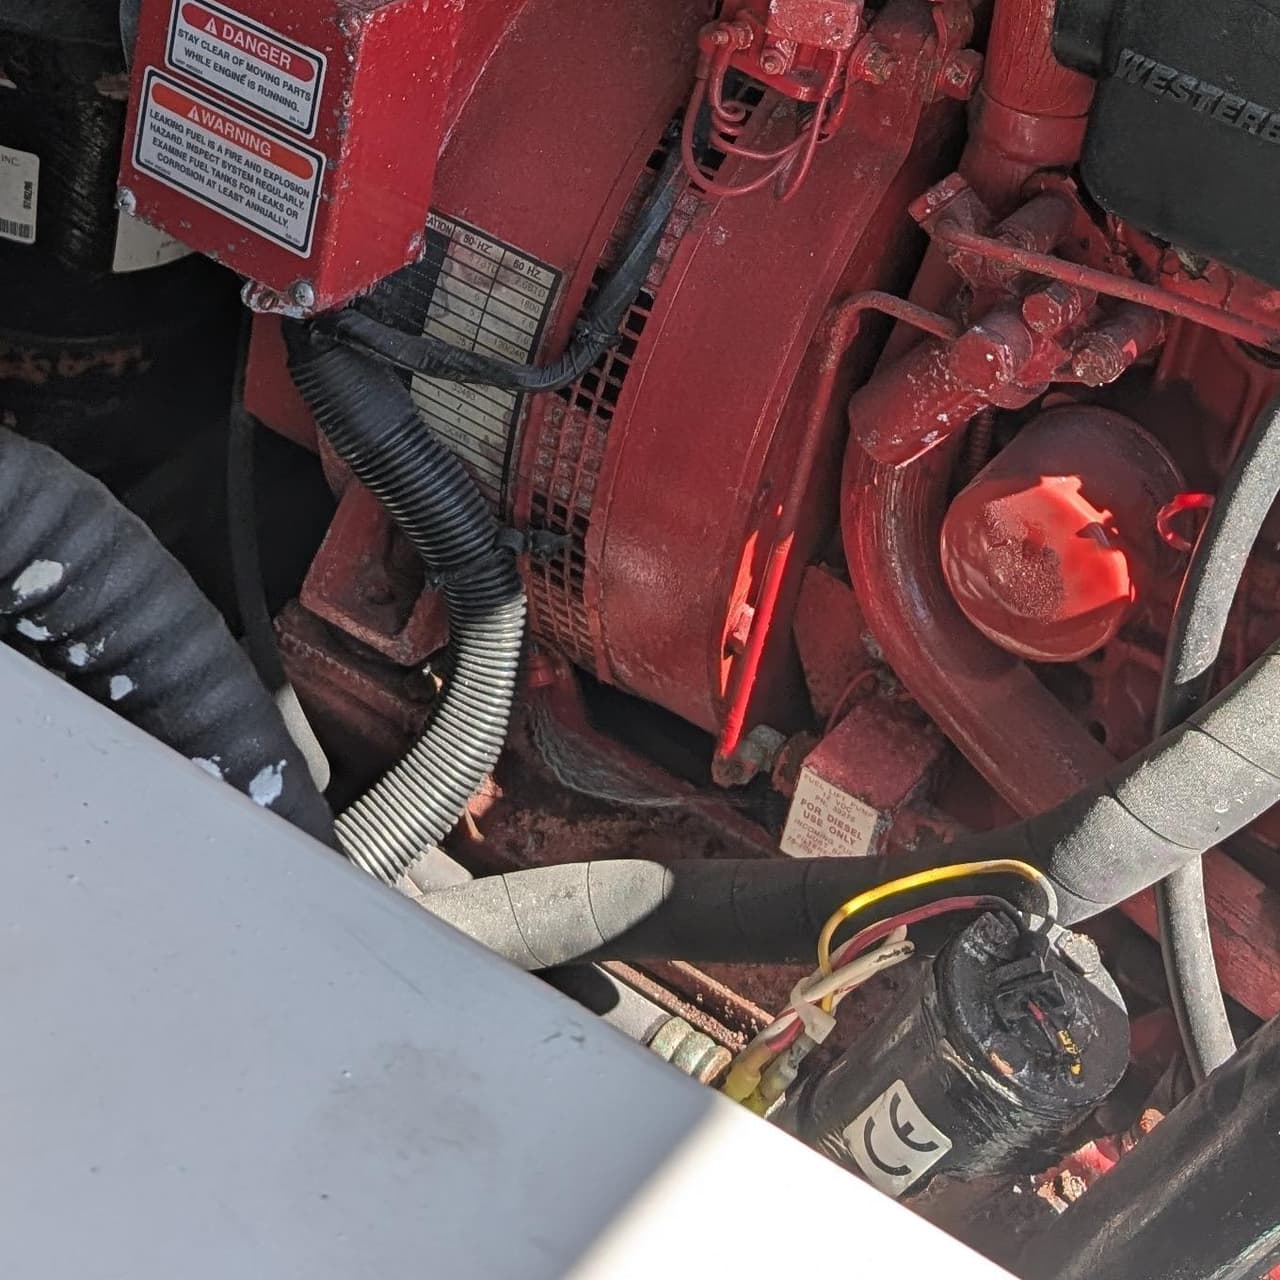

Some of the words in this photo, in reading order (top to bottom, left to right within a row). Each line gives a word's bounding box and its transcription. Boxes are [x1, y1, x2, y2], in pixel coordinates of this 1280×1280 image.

[177, 27, 200, 45] STAY
[200, 39, 230, 62] CLEAR
[231, 55, 245, 68] OF
[246, 62, 281, 88] MOVING
[282, 79, 312, 102] PARTS
[184, 47, 211, 69] WHILE
[213, 63, 247, 86] ENGINE
[247, 78, 256, 90] IS
[258, 84, 300, 113] RUNNING.
[222, 23, 292, 70] DANGER
[149, 109, 185, 134] LEAKING
[185, 127, 207, 146] FUEL
[207, 140, 216, 150] IS
[217, 144, 223, 154] A
[224, 148, 243, 164] FIRE
[244, 158, 262, 175] AND
[263, 168, 310, 199] EXPLOSION
[150, 122, 185, 147] HAZARD.
[186, 141, 220, 166] INSPECT
[221, 160, 254, 184] SYSTEM
[255, 178, 305, 211] REGULARLY.
[200, 109, 271, 158] WARNING
[152, 136, 188, 161] EXAMINE
[189, 156, 210, 174] FUEL
[211, 167, 238, 189] TANKS
[239, 181, 257, 197] FOR
[257, 191, 285, 213] LEAKS
[286, 207, 300, 221] OR
[157, 152, 206, 185] CORROSION
[206, 178, 217, 190] AT
[217, 184, 245, 206] LEAST
[245, 199, 289, 230] ANNUALLY.
[800, 798, 822, 816] FOR
[826, 814, 863, 841] DIESEL
[803, 810, 824, 827] USE
[828, 825, 857, 846] ONLY
[863, 1091, 941, 1177] CE
